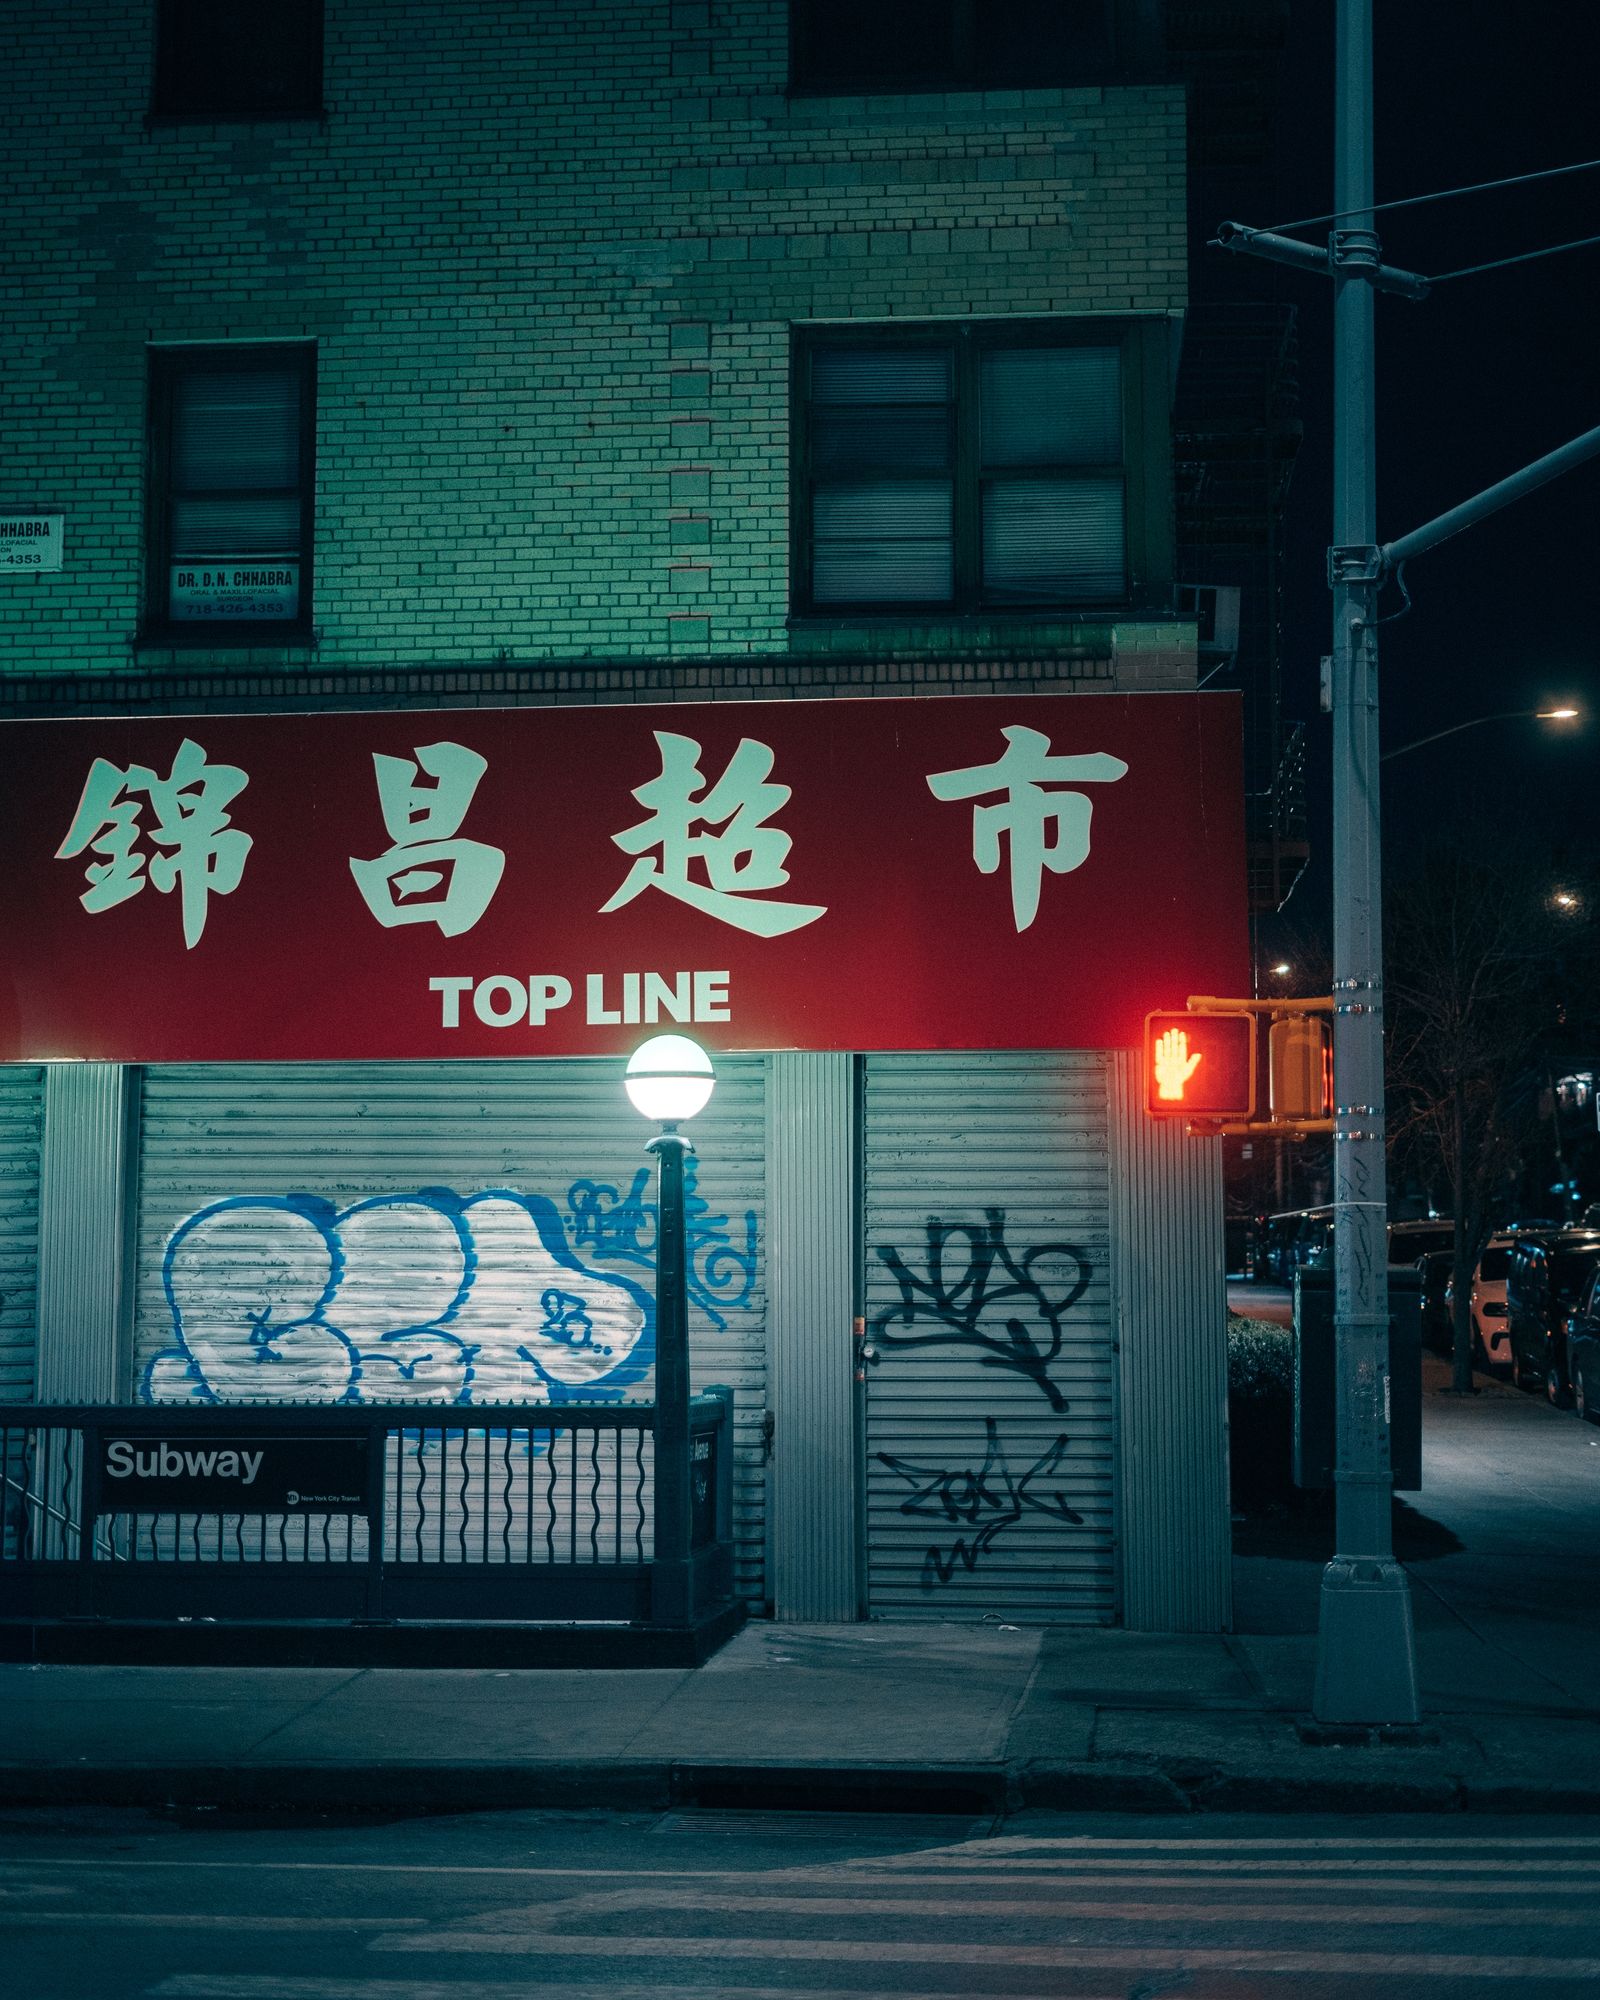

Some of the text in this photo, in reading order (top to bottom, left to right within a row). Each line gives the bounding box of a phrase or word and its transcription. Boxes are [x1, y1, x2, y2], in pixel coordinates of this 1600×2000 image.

[0, 554, 41, 564] -4353
[178, 573, 198, 588] DR.
[233, 571, 292, 587] CHHABRA
[186, 603, 284, 614] 718-426-4353
[53, 724, 1129, 950] 錦昌超市
[429, 970, 731, 1028] TOP LINE
[106, 1441, 264, 1484] Subway
[328, 1495, 340, 1503] City
